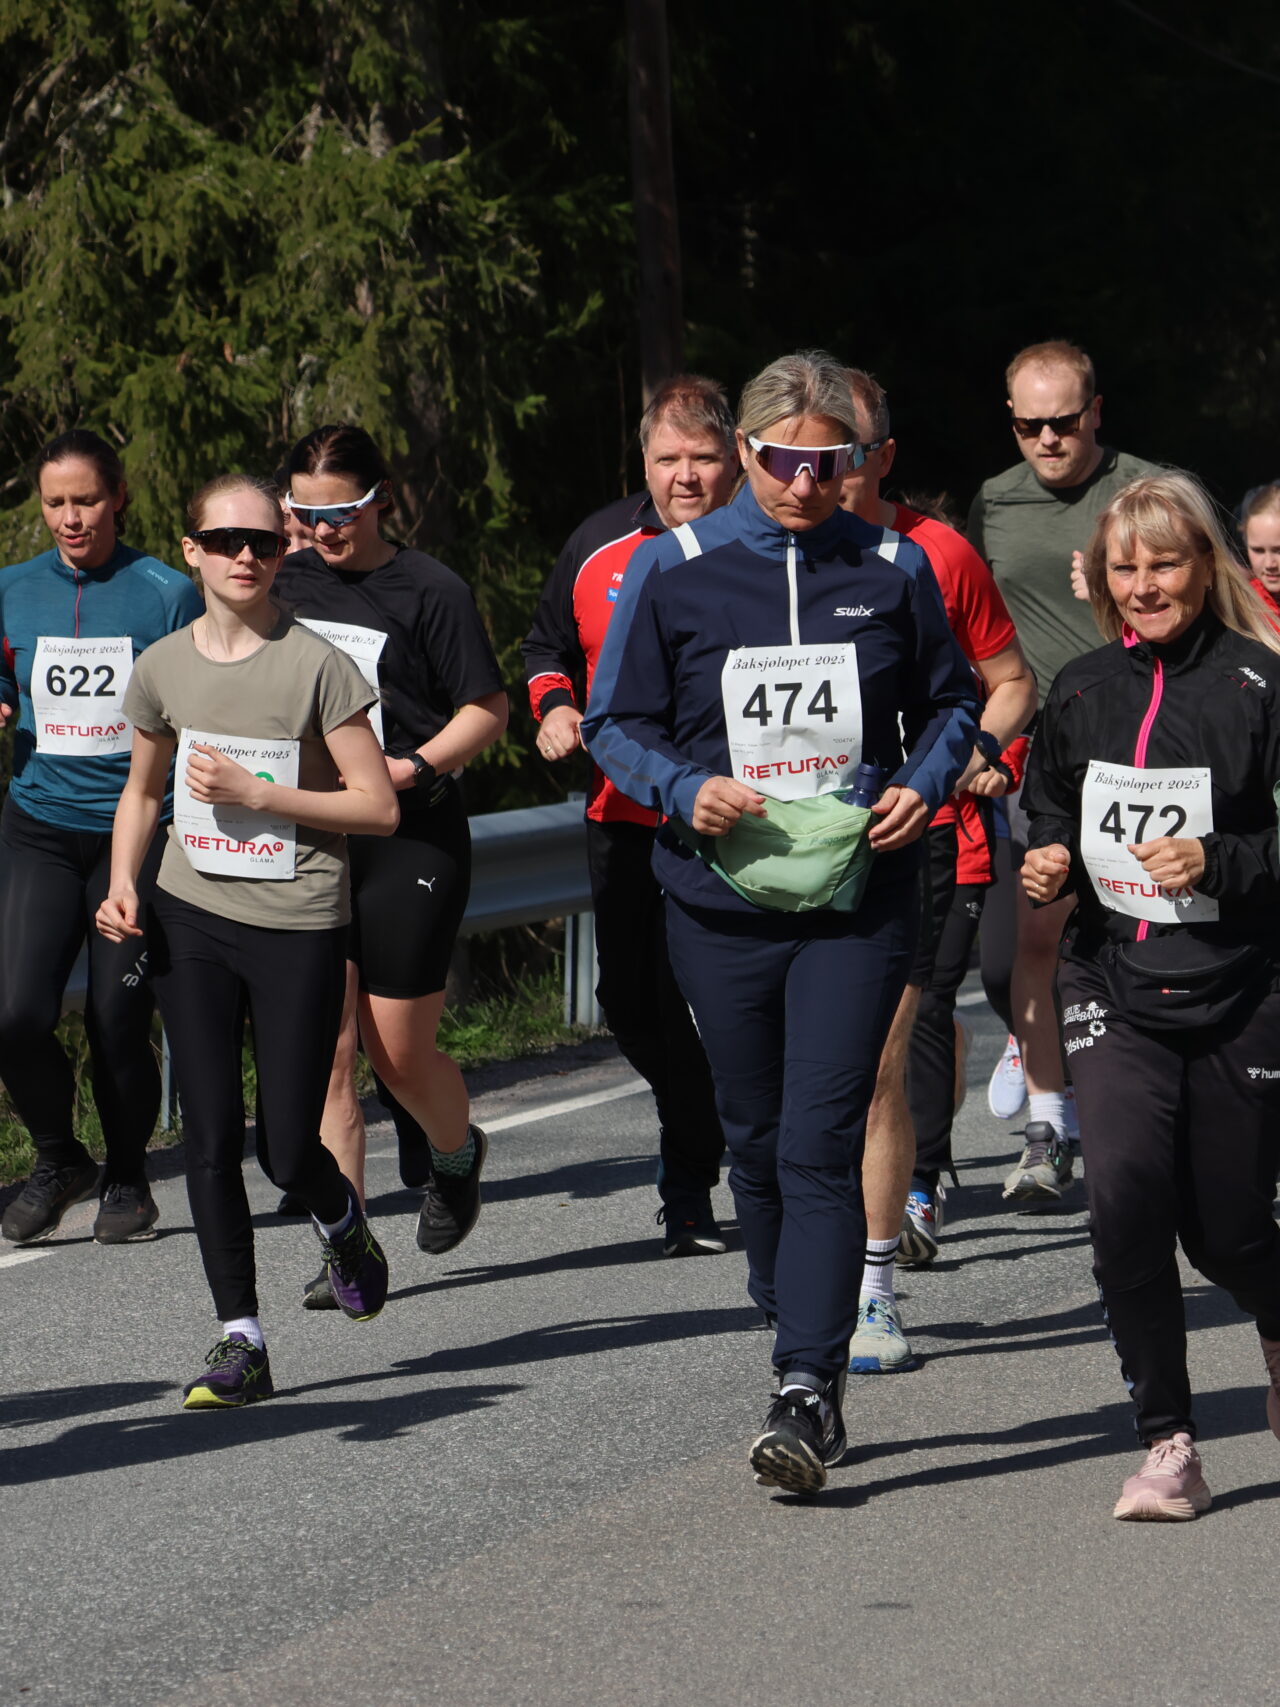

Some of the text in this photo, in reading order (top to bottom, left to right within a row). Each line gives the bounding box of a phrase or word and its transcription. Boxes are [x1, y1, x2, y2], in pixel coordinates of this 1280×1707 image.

[99, 645, 125, 655] 2025
[814, 655, 846, 666] 2025
[46, 664, 116, 697] 622
[742, 679, 839, 727] 474
[44, 723, 119, 737] RETURA
[260, 750, 291, 760] 2025
[743, 756, 838, 779] RETURA
[1167, 779, 1201, 790] 2025
[1099, 800, 1188, 845] 472
[184, 833, 274, 857] RETURA
